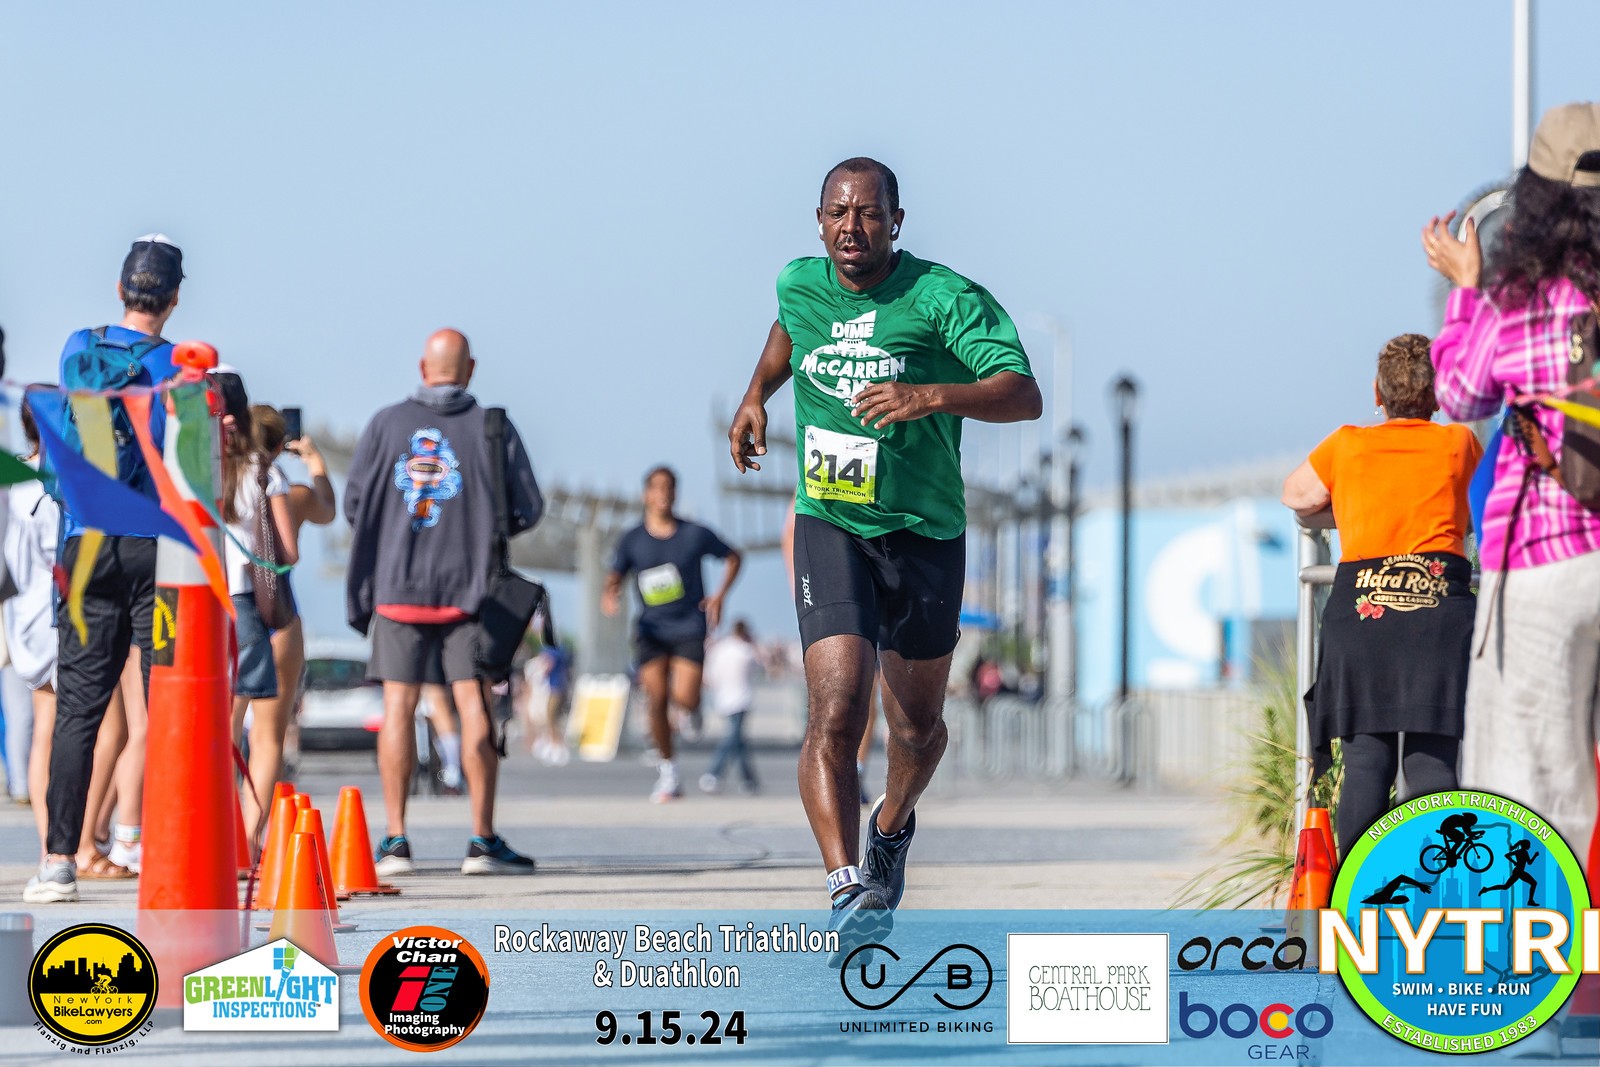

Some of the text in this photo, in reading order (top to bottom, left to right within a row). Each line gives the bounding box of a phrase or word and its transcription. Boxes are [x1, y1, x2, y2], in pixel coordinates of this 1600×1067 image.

[831, 318, 876, 338] DIME
[799, 354, 906, 379] McCARREN
[806, 448, 866, 488] 214
[832, 487, 867, 498] TRIATHLON
[1382, 554, 1431, 568] SEMINOLE
[1355, 568, 1406, 589] Hard
[829, 872, 845, 889] 214
